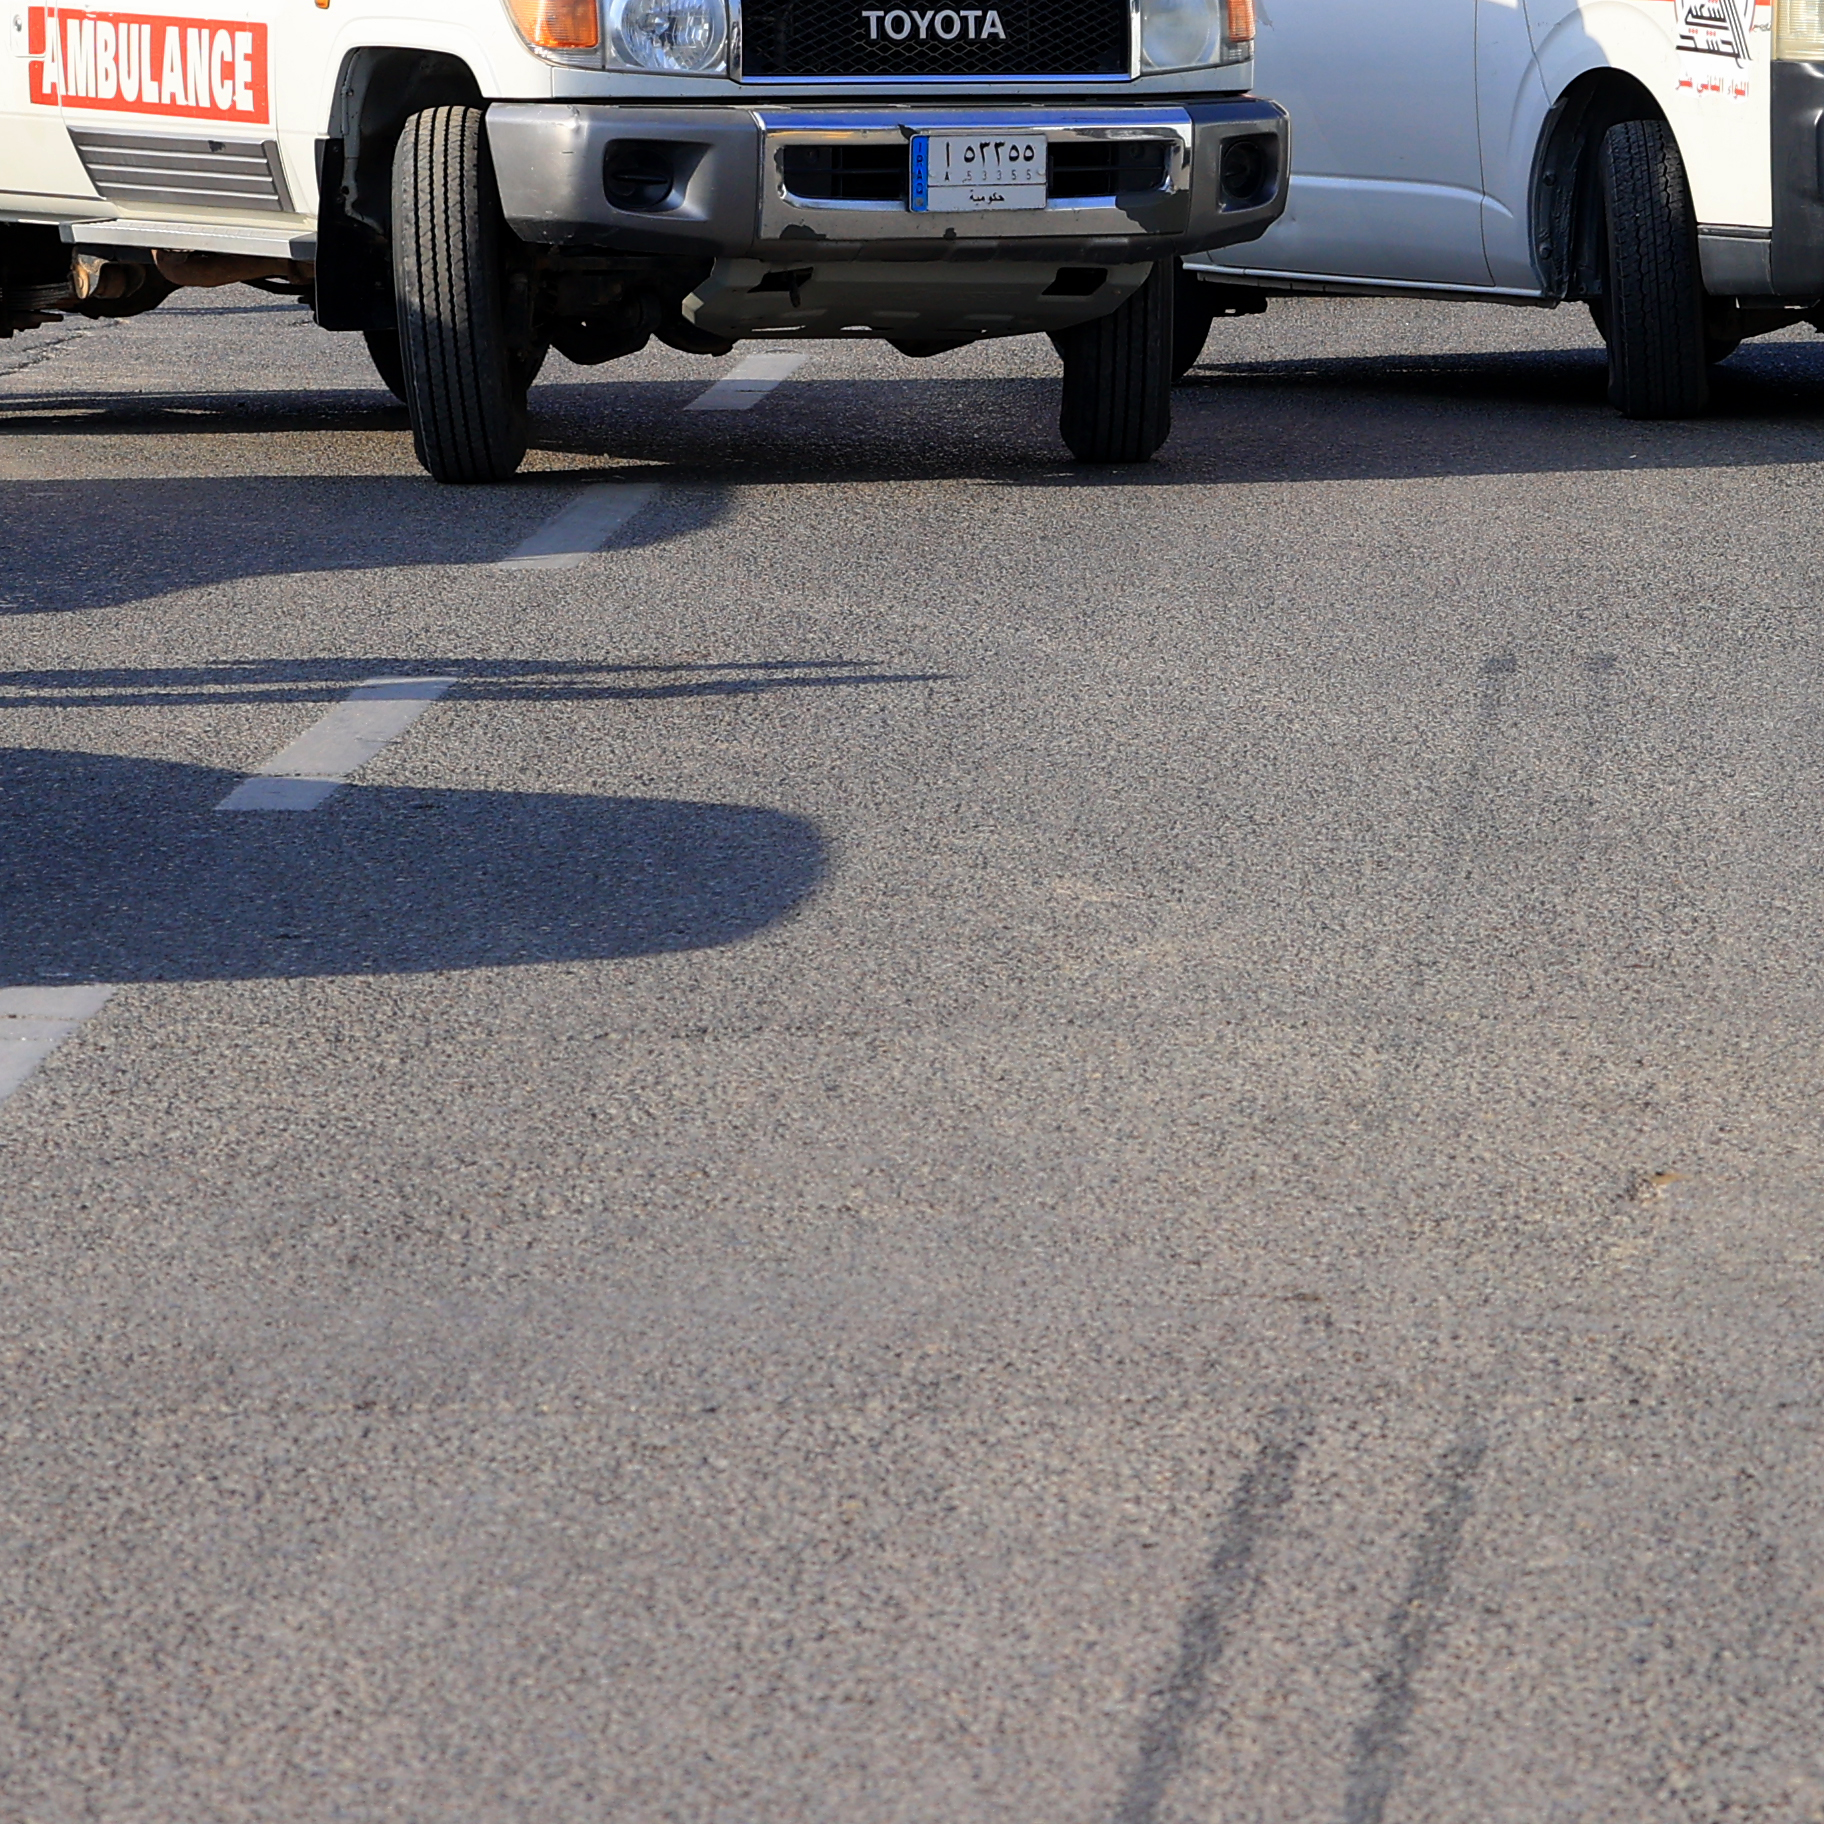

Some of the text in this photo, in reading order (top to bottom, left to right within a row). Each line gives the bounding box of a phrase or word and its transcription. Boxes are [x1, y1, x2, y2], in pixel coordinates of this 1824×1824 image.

[861, 8, 1007, 40] TOYOTA
[41, 16, 255, 112] AMBULANCE
[963, 141, 1036, 168] ٥٣٣٥٥
